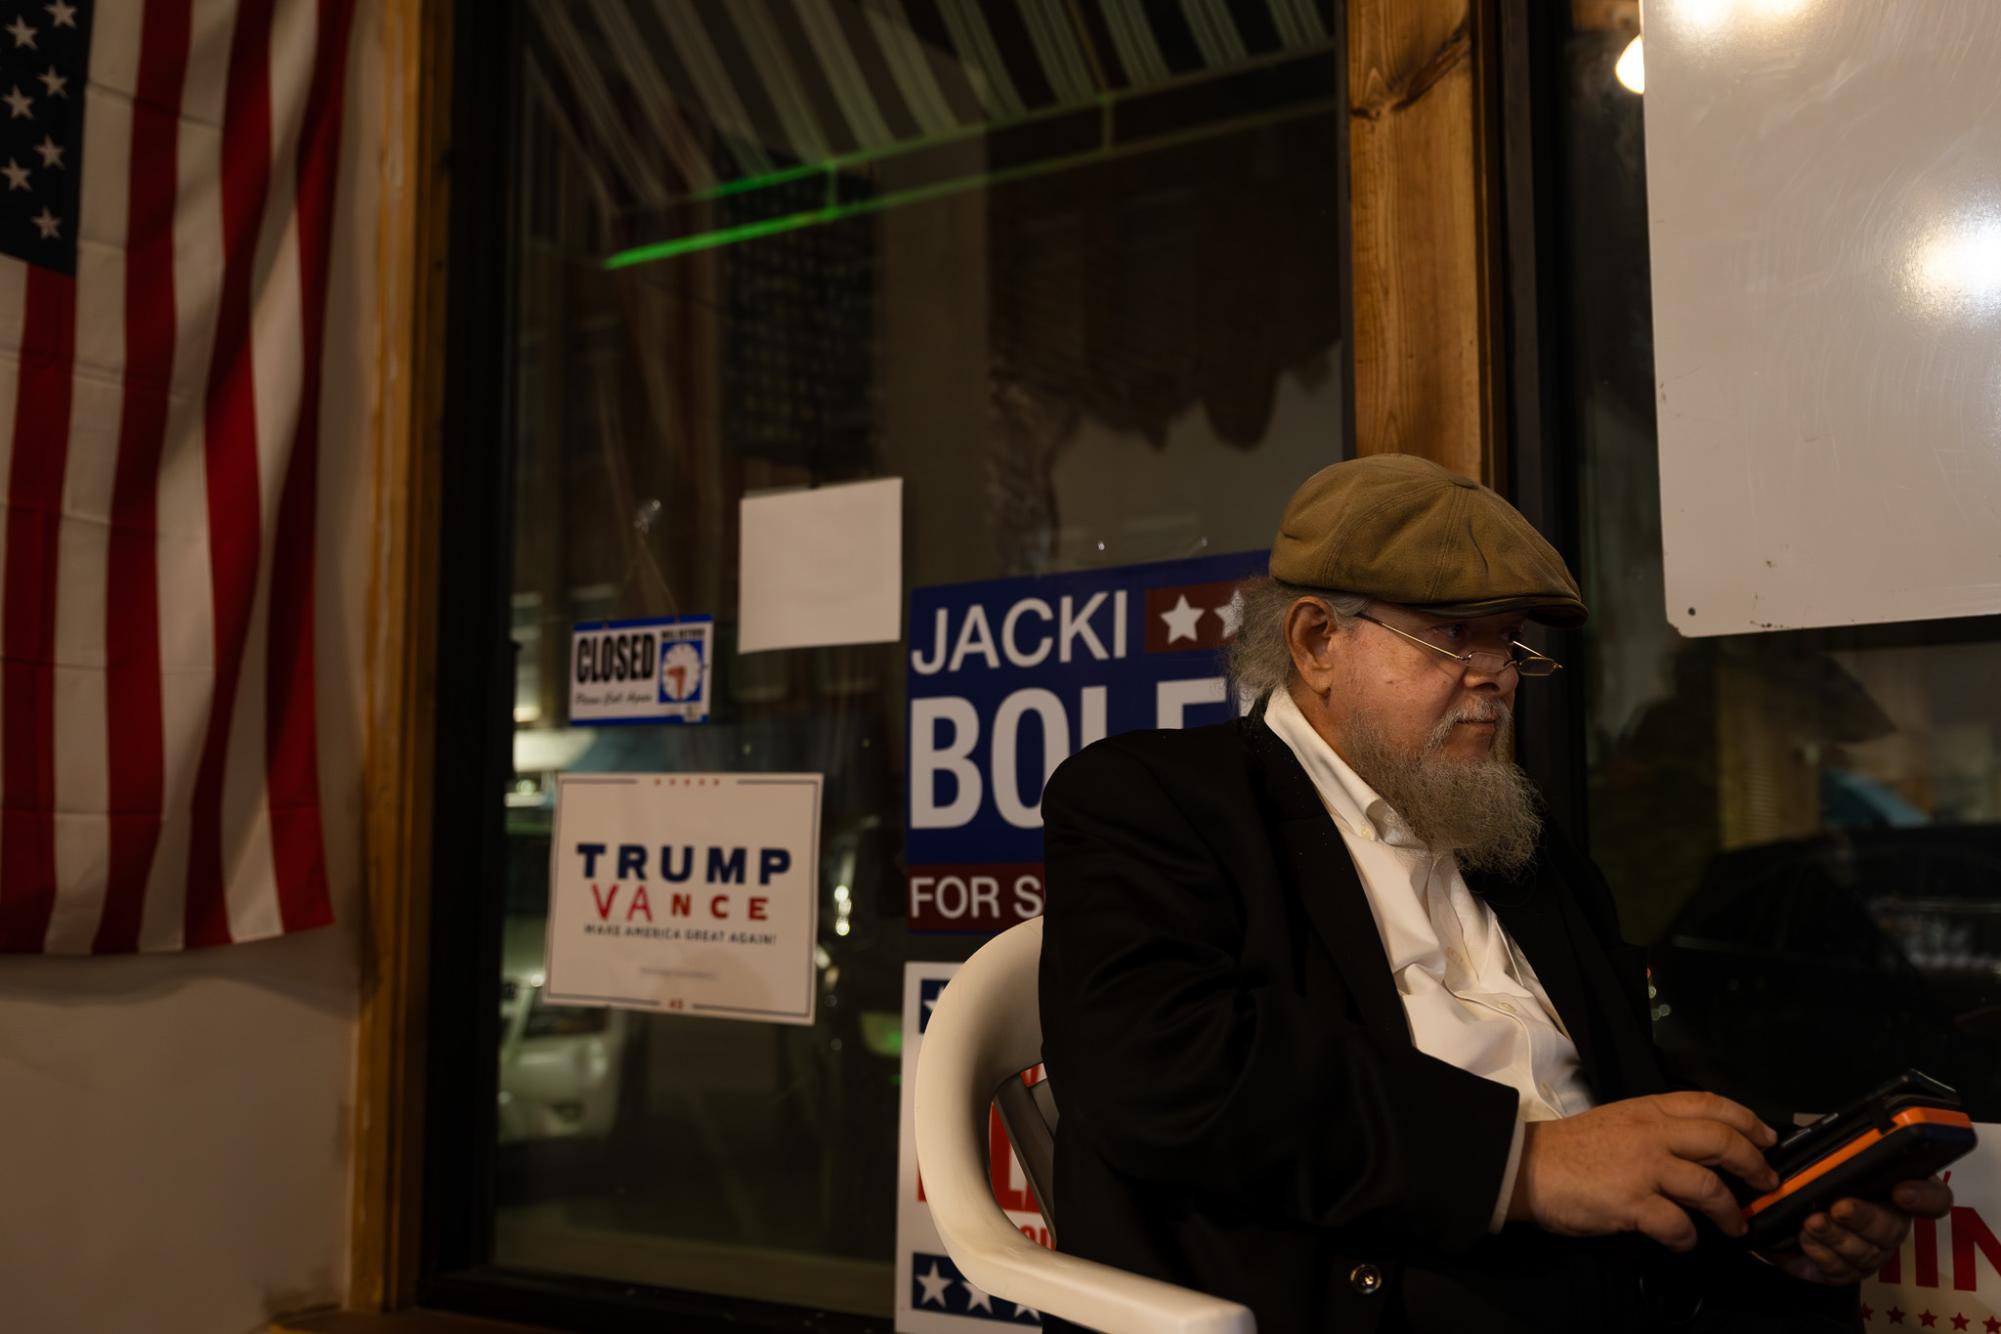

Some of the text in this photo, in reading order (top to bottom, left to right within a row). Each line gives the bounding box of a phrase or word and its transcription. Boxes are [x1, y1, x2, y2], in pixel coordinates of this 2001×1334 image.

[911, 589, 1128, 675] JACKI
[577, 634, 655, 683] CLOSED
[576, 843, 792, 885] TRUMP
[591, 883, 769, 923] VANCE
[910, 875, 1044, 920] FOR S
[584, 924, 777, 945] MAKE AMERICA GREAT AGAIN!
